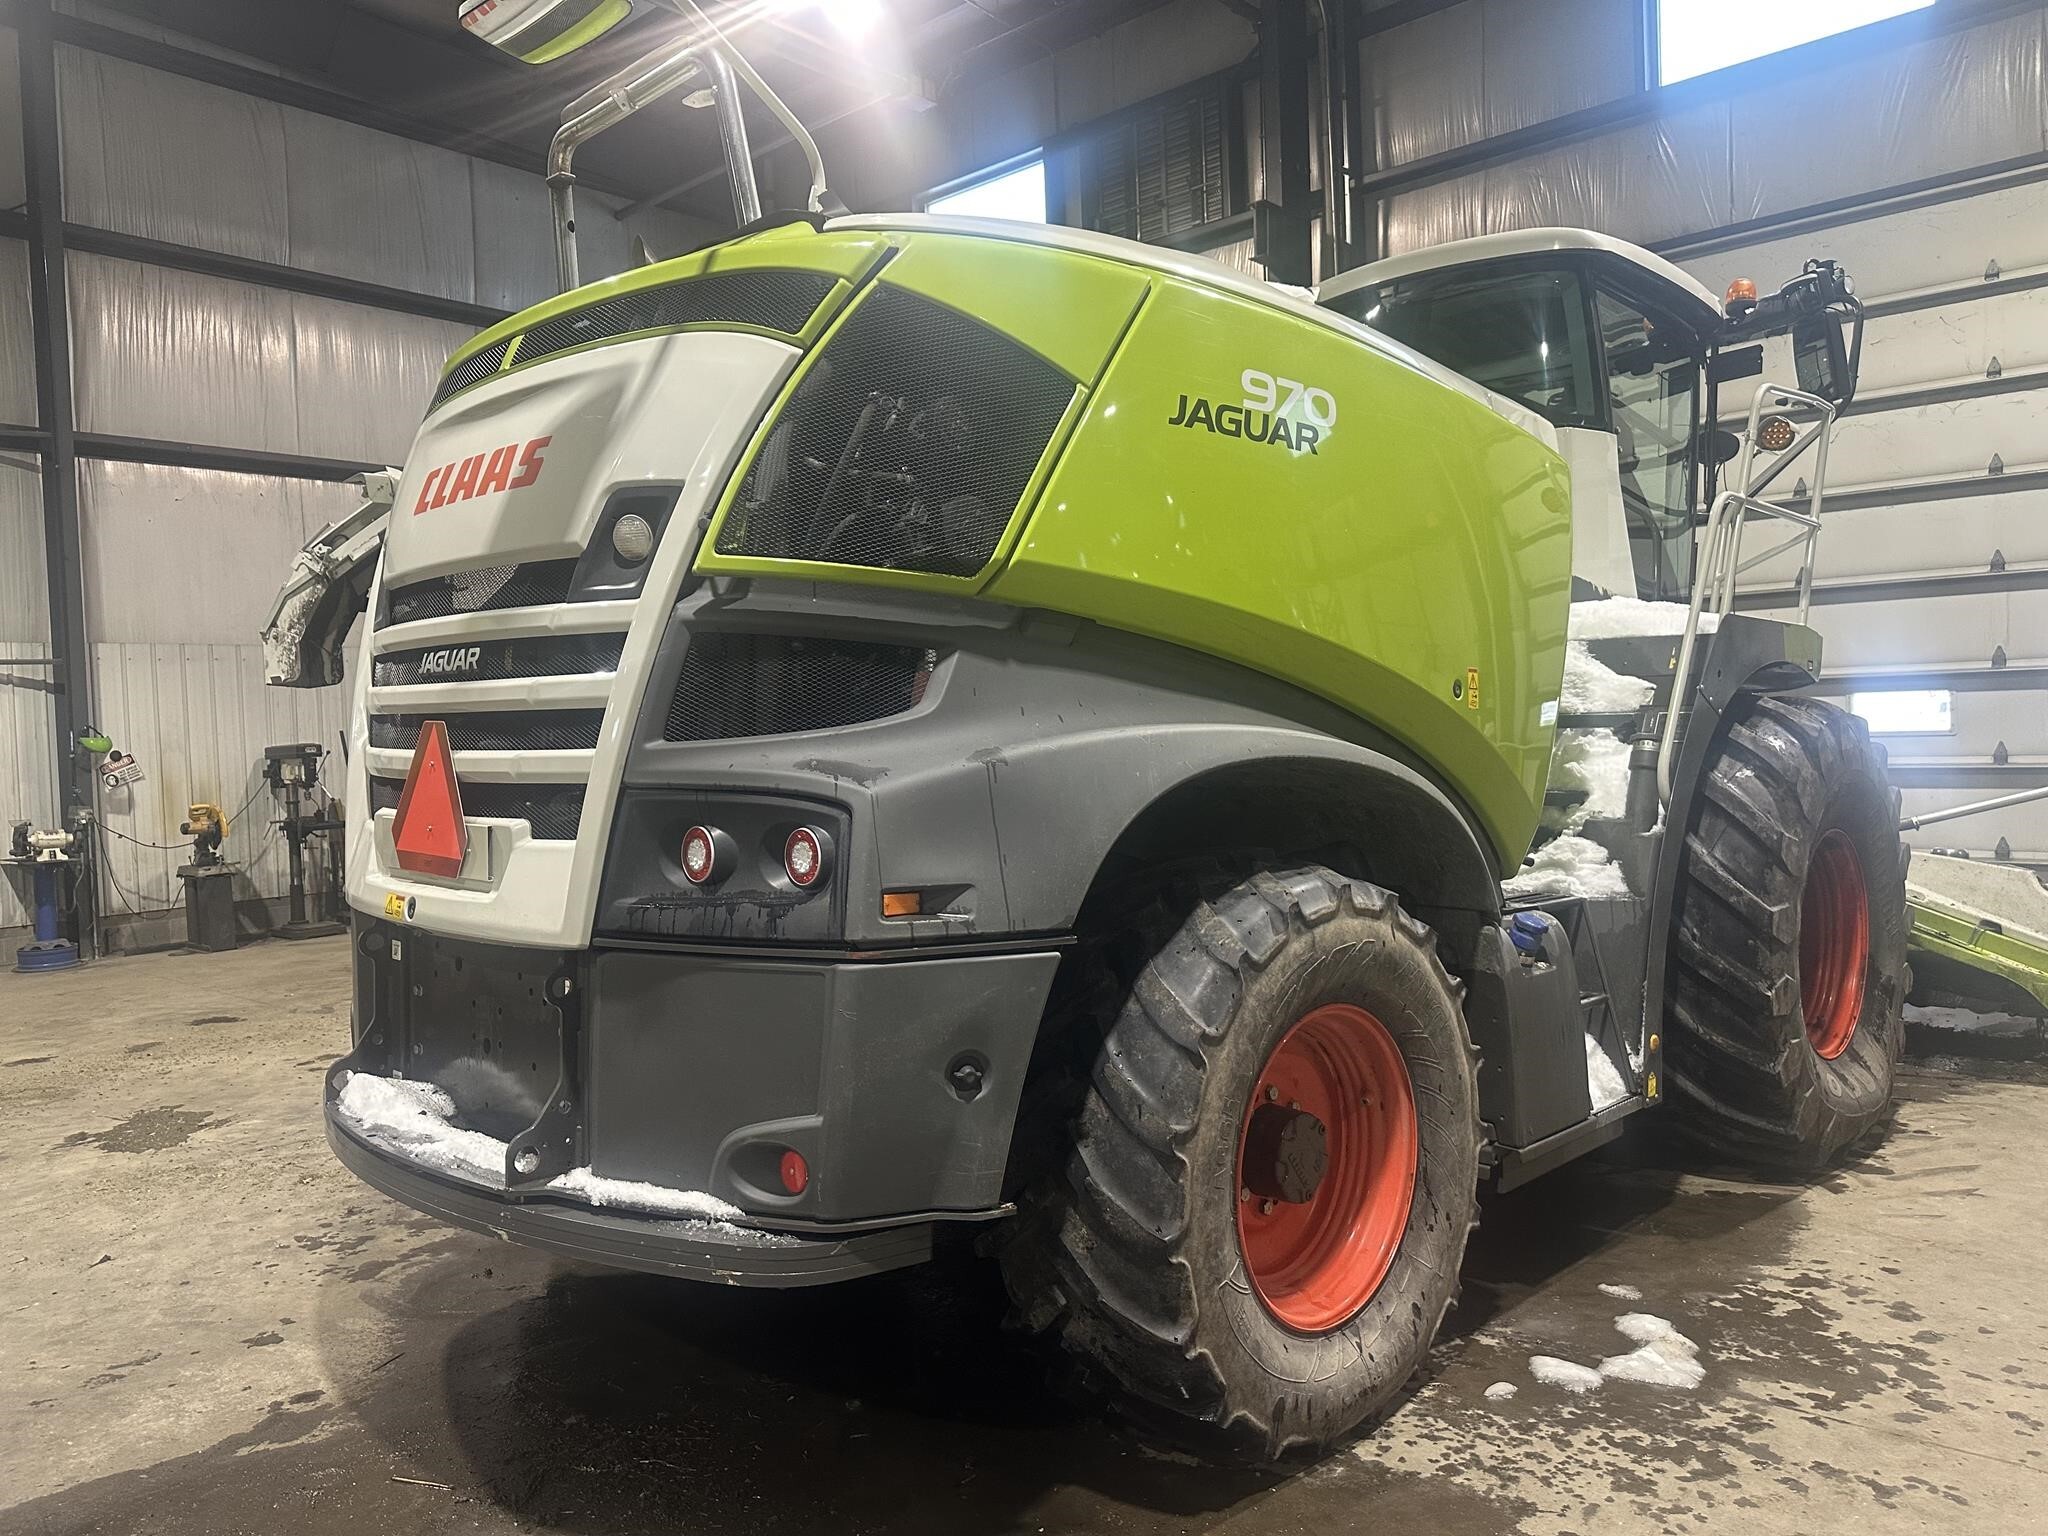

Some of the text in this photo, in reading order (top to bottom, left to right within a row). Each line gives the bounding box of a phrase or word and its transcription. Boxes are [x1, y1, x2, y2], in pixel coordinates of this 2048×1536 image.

[1168, 394, 1318, 456] JAGUAR
[1241, 368, 1337, 428] 970
[413, 435, 553, 516] CLAAS
[418, 647, 481, 674] JAGUAR
